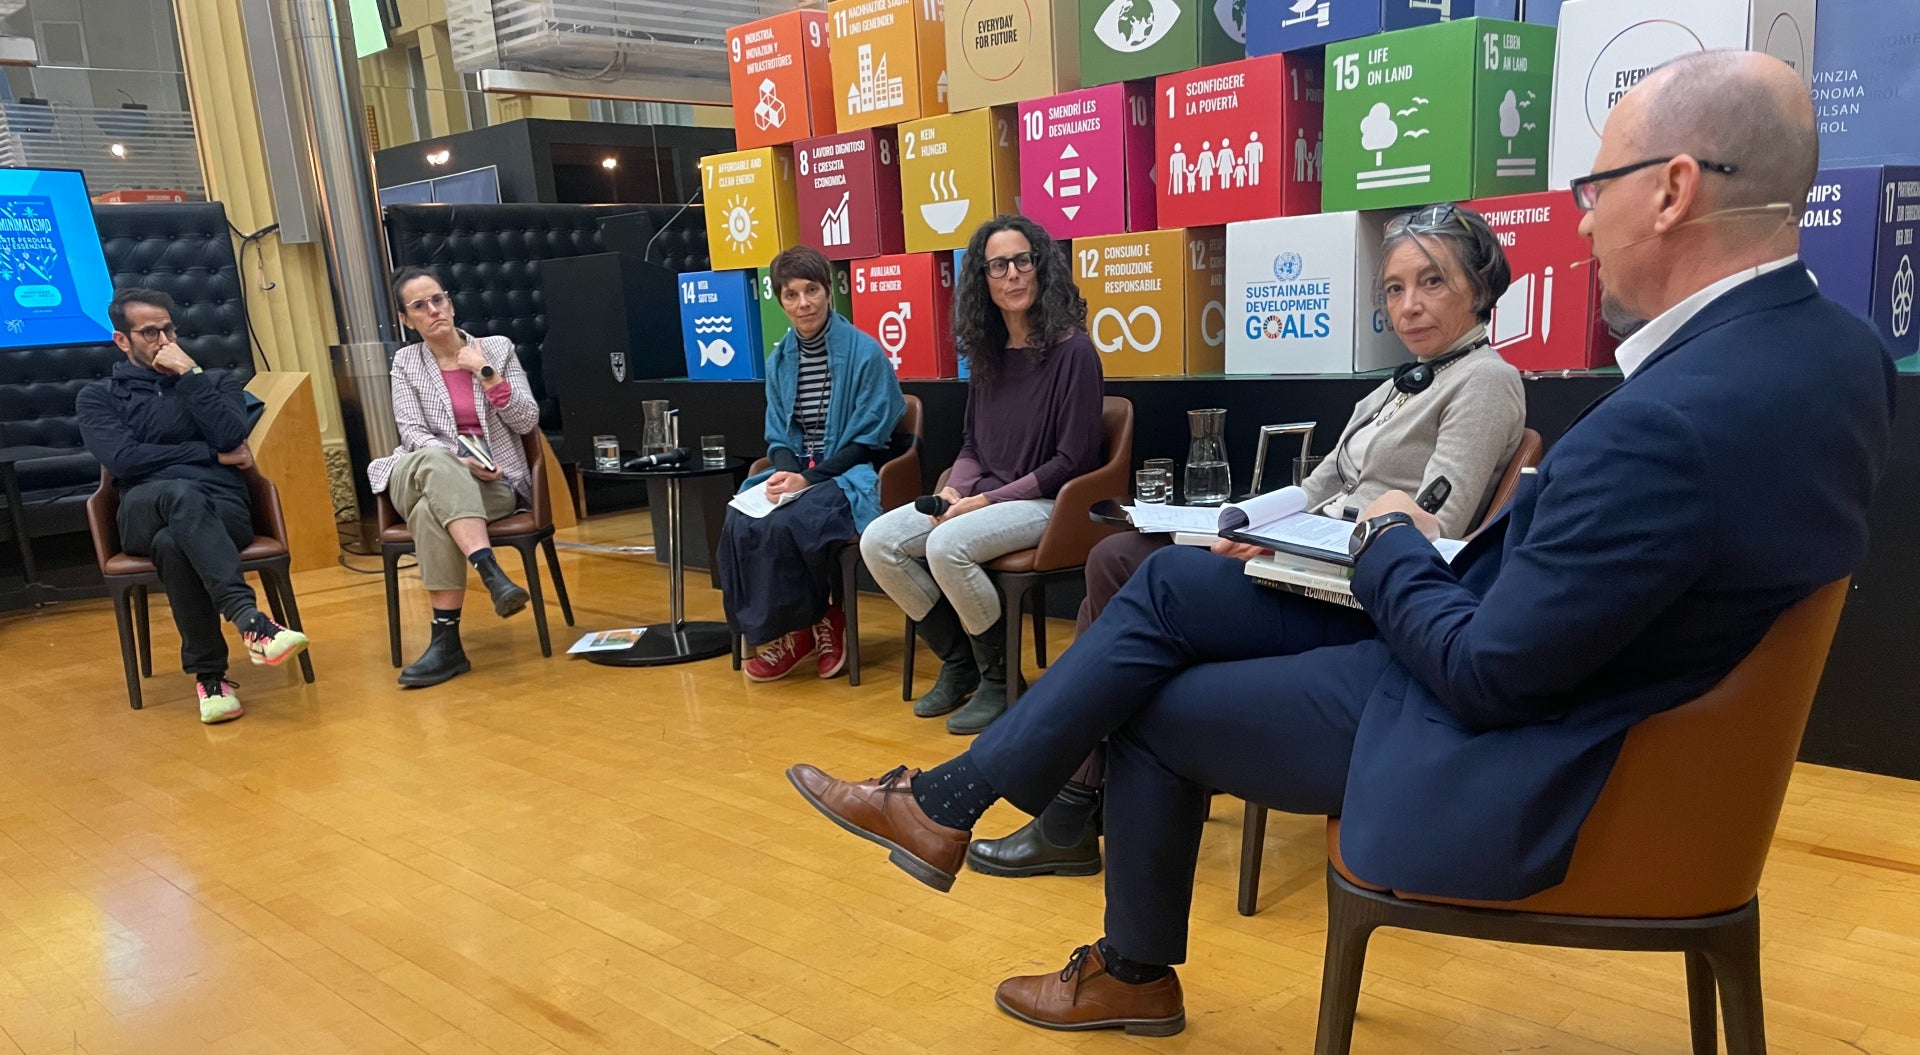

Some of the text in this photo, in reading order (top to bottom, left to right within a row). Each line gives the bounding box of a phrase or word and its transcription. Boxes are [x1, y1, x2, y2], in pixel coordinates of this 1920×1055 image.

[809, 21, 821, 47] 9
[833, 9, 848, 38] 11
[849, 22, 861, 35] UND
[978, 14, 1014, 34] EVERYDAY
[732, 37, 741, 63] 9
[975, 29, 1018, 50] FOR FUTURE
[1483, 32, 1499, 70] 15
[1502, 34, 1521, 50] LEBEN
[1368, 47, 1389, 65] LIFE
[1502, 56, 1528, 72] AN LAND
[1333, 53, 1360, 91] 15
[1367, 64, 1413, 86] ON LAND
[1186, 73, 1245, 97] SCONFIGGERE
[1290, 68, 1299, 101] 1
[1048, 99, 1096, 120] SMENDRÍ LES
[1129, 95, 1147, 127] 10
[1165, 86, 1175, 119] 1
[1186, 91, 1238, 116] LA POVERTÀ
[920, 128, 935, 141] KEIN
[998, 119, 1009, 147] 2
[1023, 110, 1044, 142] 10
[1048, 117, 1101, 138] DESVALIANZES
[812, 139, 865, 159] LAVORO DIGNITOSO
[879, 139, 891, 165] 8
[904, 132, 916, 160] 2
[921, 142, 947, 157] HUNGER
[780, 157, 789, 181] 7
[799, 150, 809, 176] 8
[813, 158, 845, 174] E CRESCITA
[706, 165, 714, 190] 7
[814, 174, 847, 189] ECONOMICA
[1885, 182, 1896, 223] 17
[1104, 243, 1150, 259] CONSUMO E
[1189, 240, 1206, 270] 12
[941, 262, 951, 288] 5
[1078, 249, 1099, 278] 12
[1104, 261, 1153, 277] PRODUZIONE
[682, 281, 696, 304] 14
[763, 276, 772, 300] 3
[838, 270, 849, 295] 3
[855, 268, 865, 293] 5
[870, 280, 902, 292] DE GENDER
[1104, 278, 1162, 294] RESPONSABILE
[1246, 282, 1330, 299] SUSTAINABLE
[1246, 298, 1330, 313] DEVELOPMENT
[1246, 312, 1330, 340] GOALS
